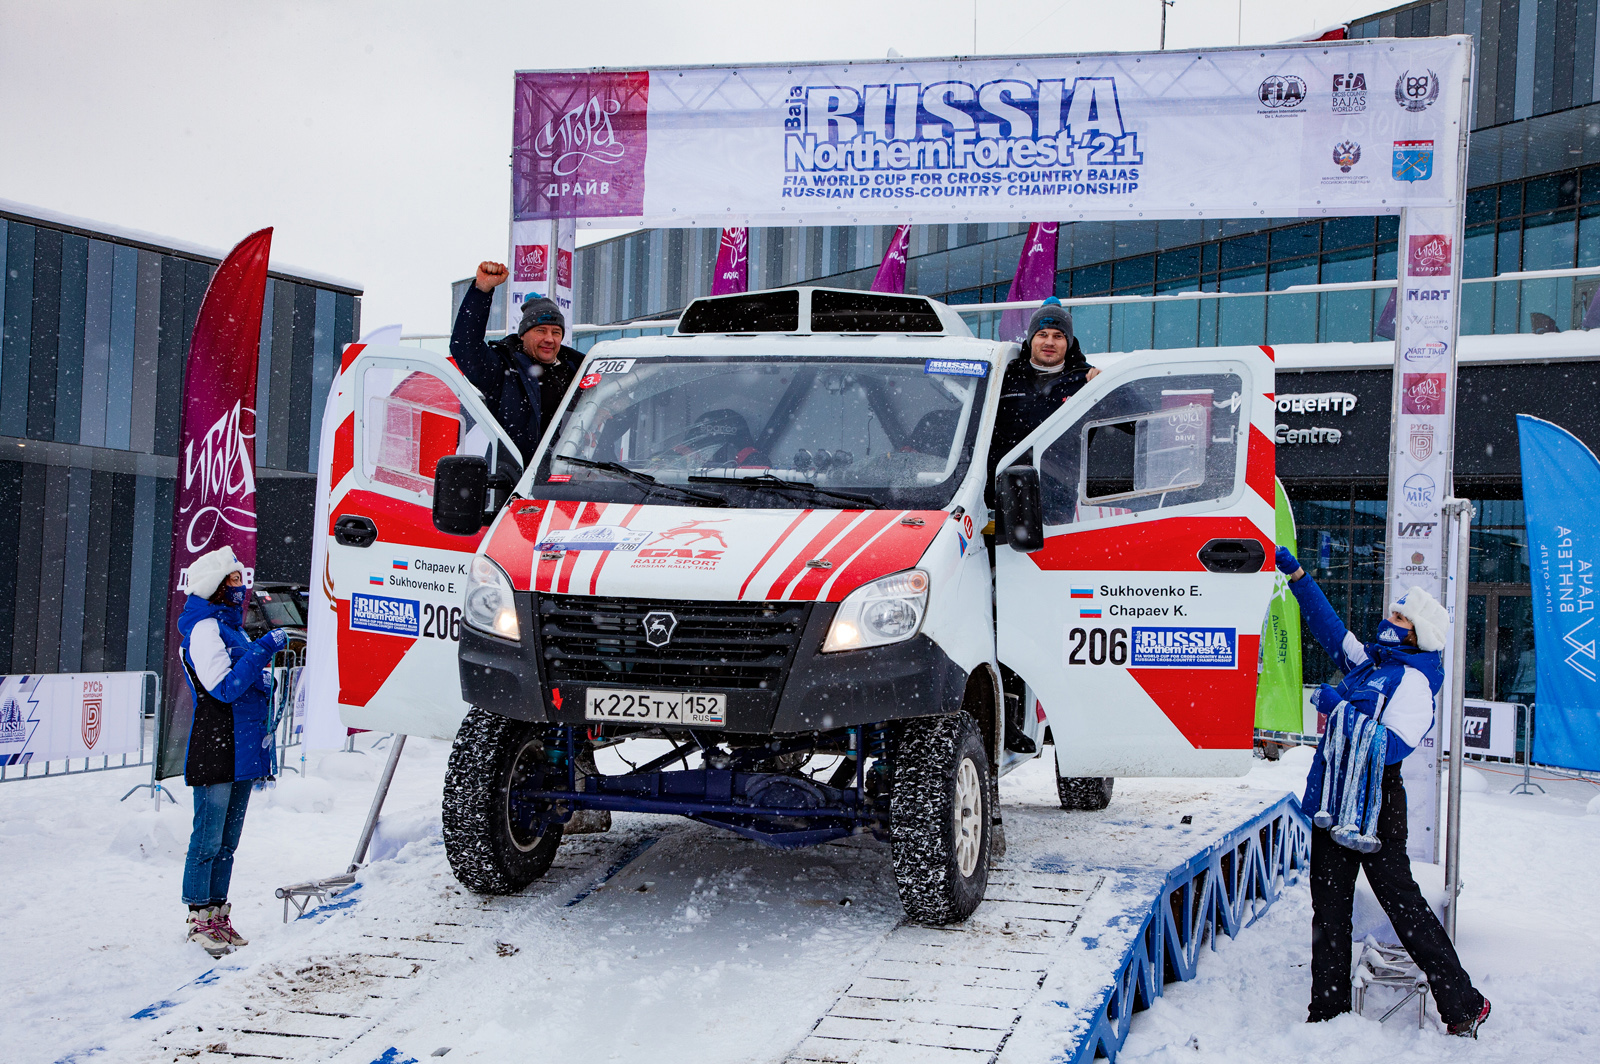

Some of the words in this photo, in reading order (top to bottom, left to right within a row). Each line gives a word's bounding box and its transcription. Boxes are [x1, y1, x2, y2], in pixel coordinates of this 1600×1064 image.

[785, 87, 802, 131] Baja
[806, 77, 1125, 137] RUSSIA
[1333, 96, 1366, 107] BAJAS
[785, 132, 950, 172] Northern
[950, 129, 1075, 169] Forest
[783, 175, 808, 187] FIA
[812, 174, 870, 186] WORLD
[874, 174, 907, 186] CUP
[911, 173, 943, 185] FOR
[947, 169, 1083, 184] CROSS-COUNTRY
[1087, 168, 1140, 181] BAJAS
[547, 179, 610, 198] ДРАЙВ
[782, 187, 855, 199] RUSSIAN
[860, 185, 1002, 199] CROSS-COUNTRY
[1007, 183, 1139, 196] CHAMPIONSHIP
[1407, 289, 1451, 301] NART
[596, 361, 627, 373] 206
[932, 361, 983, 370] RUSSIA
[1275, 397, 1356, 416] оцентр
[1410, 423, 1434, 431] РУСЬ
[1398, 522, 1438, 537] VRT
[616, 543, 637, 551] 206
[638, 549, 726, 560] GAZ
[414, 559, 456, 574] Chapaev
[457, 564, 468, 575] K.
[389, 575, 445, 592] Sukhovenko
[447, 583, 457, 594] E.
[1100, 585, 1185, 597] Sukhovenko
[1189, 585, 1203, 597] E.
[354, 609, 384, 621] Northern
[358, 597, 415, 618] RUSSIA
[1109, 604, 1169, 618] Chapaev
[1173, 605, 1188, 617] K.
[423, 603, 463, 642] 206
[1069, 627, 1128, 665] 206
[1142, 631, 1228, 647] RUSSIA
[1135, 643, 1182, 654] Northern
[1182, 644, 1214, 655] Forest
[83, 681, 103, 692] РУСЬ
[685, 696, 718, 714] 152
[693, 714, 710, 722] RUS
[0, 721, 25, 731] USSIA
